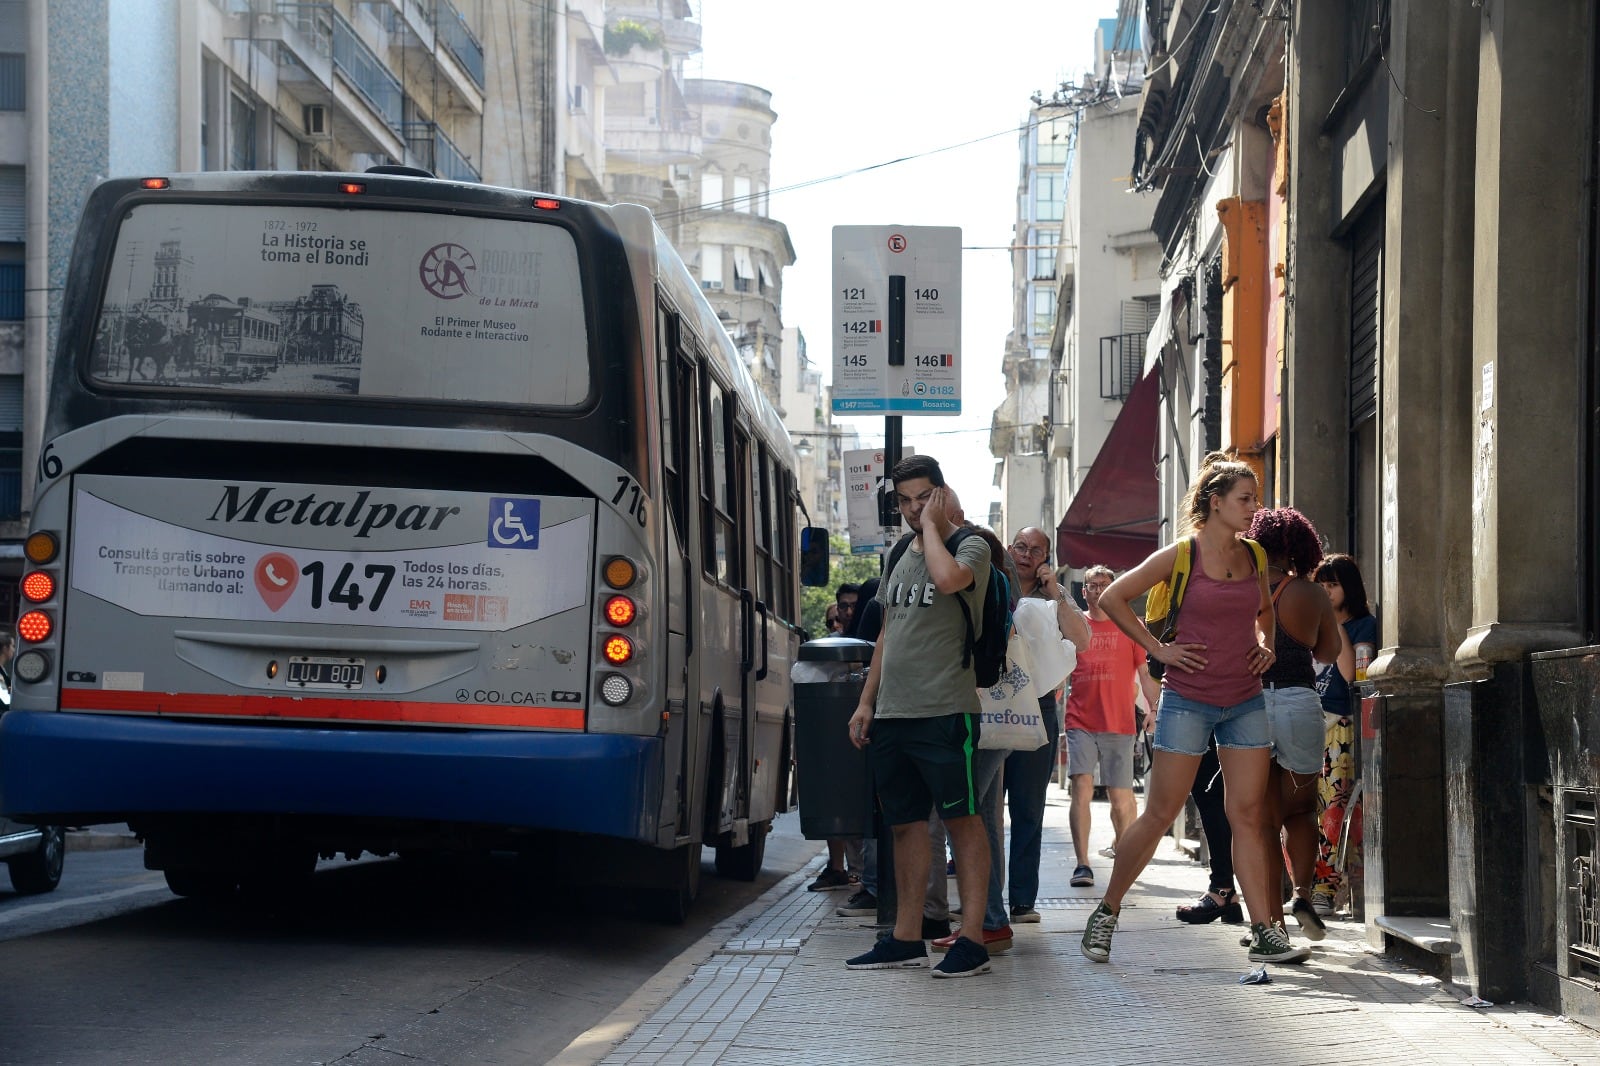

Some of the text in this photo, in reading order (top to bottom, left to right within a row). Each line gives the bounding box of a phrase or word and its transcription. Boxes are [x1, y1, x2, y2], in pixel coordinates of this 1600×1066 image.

[263, 220, 286, 231] 1872
[295, 221, 318, 232] 1972
[262, 233, 367, 251] La Historia se
[261, 248, 369, 266] toma el Bondi
[842, 288, 865, 300] 121
[914, 288, 939, 301] 140
[479, 296, 539, 309] de La Mixta
[435, 316, 516, 330] El Primer Museo
[842, 321, 868, 334] 142
[421, 326, 463, 338] Rodante
[475, 330, 529, 342] Interactivo
[842, 354, 868, 367] 145
[914, 355, 939, 367] 146
[929, 386, 955, 395] 6182
[922, 400, 950, 408] Rosario
[849, 466, 863, 474] 101
[851, 484, 865, 492] 102
[206, 485, 461, 538] Metalpar
[98, 545, 246, 565] Consultá gratis sobre
[114, 561, 245, 579] Transporte Urbano
[403, 560, 505, 578] Todos los días,
[158, 578, 244, 594] llamando al:
[301, 560, 397, 612] 147
[402, 575, 491, 591] las 24 horas.
[409, 599, 431, 610] EMR
[289, 664, 361, 684] LUJ 801
[473, 689, 547, 705] COLCAR
